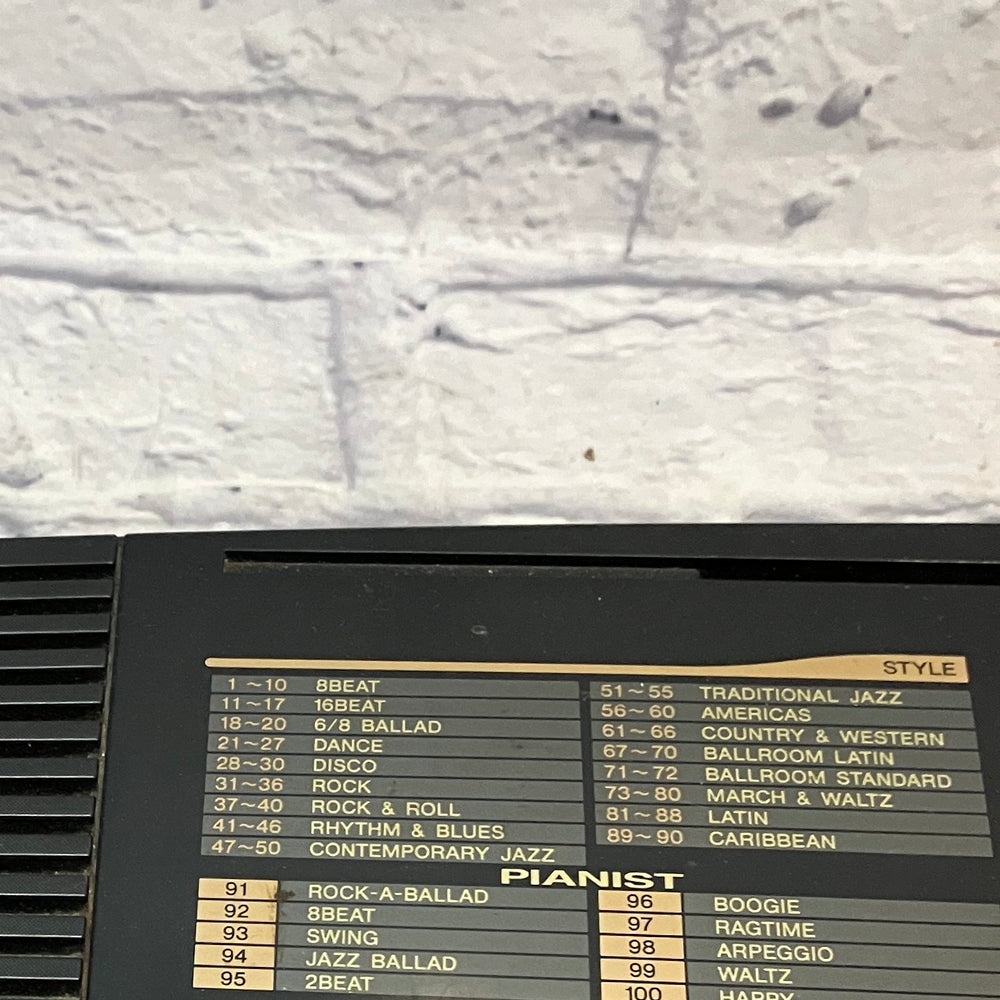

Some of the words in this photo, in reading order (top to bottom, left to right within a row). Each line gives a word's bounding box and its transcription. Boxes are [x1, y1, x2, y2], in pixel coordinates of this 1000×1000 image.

[884, 661, 956, 676] STYLE
[317, 679, 380, 692] 8BEAT
[699, 687, 839, 703] TRADITIONAL
[850, 691, 902, 704] JAZZ
[315, 699, 386, 712] 16BEAT
[702, 707, 811, 721] AMERICAS
[315, 719, 350, 731] 6/8
[362, 719, 441, 733] BALLAD
[702, 727, 804, 741] COUNTRY
[816, 730, 829, 743] &
[840, 731, 944, 745] WESTERN
[314, 739, 382, 752] DANCE
[704, 747, 823, 763] BALLROOM
[835, 751, 894, 765] LATIN
[314, 759, 376, 773] DISCO
[706, 768, 825, 784] BALLROOM
[837, 771, 951, 788] STANDARD
[313, 779, 371, 793] ROCK
[707, 789, 785, 804] MARCH
[798, 792, 810, 805] &
[821, 792, 893, 807] WALTZ
[312, 800, 370, 814] ROCK
[382, 802, 395, 815] &
[407, 802, 460, 816] ROLL
[709, 810, 768, 825] LATIN
[311, 821, 400, 836] RHYTHM
[412, 824, 424, 837] &
[437, 824, 504, 839] BLUES
[710, 832, 835, 849] CARIBBEAN
[310, 842, 489, 860] CONTEMPORARY
[501, 848, 554, 862] JAZZ
[501, 868, 684, 889] PIANIST
[226, 882, 246, 895] 91
[309, 885, 488, 903] ROCK-A-BALLAD
[627, 894, 652, 908] 96
[715, 897, 800, 914] BOOGIE
[225, 904, 249, 918] 92
[308, 907, 376, 922] 8BEAT
[628, 917, 652, 931] 97
[716, 920, 815, 937] RAGTIME
[224, 926, 248, 940] 93
[307, 929, 378, 945] SWING
[629, 940, 655, 954] 98
[717, 943, 833, 961] ARPEGGIO
[222, 949, 247, 963] 94
[306, 952, 360, 967] JAZZ
[372, 954, 456, 971] BALLAD
[630, 963, 655, 978] 99
[718, 967, 792, 984] WALTZ
[221, 971, 245, 986] 95
[306, 975, 374, 991] 2BEAT
